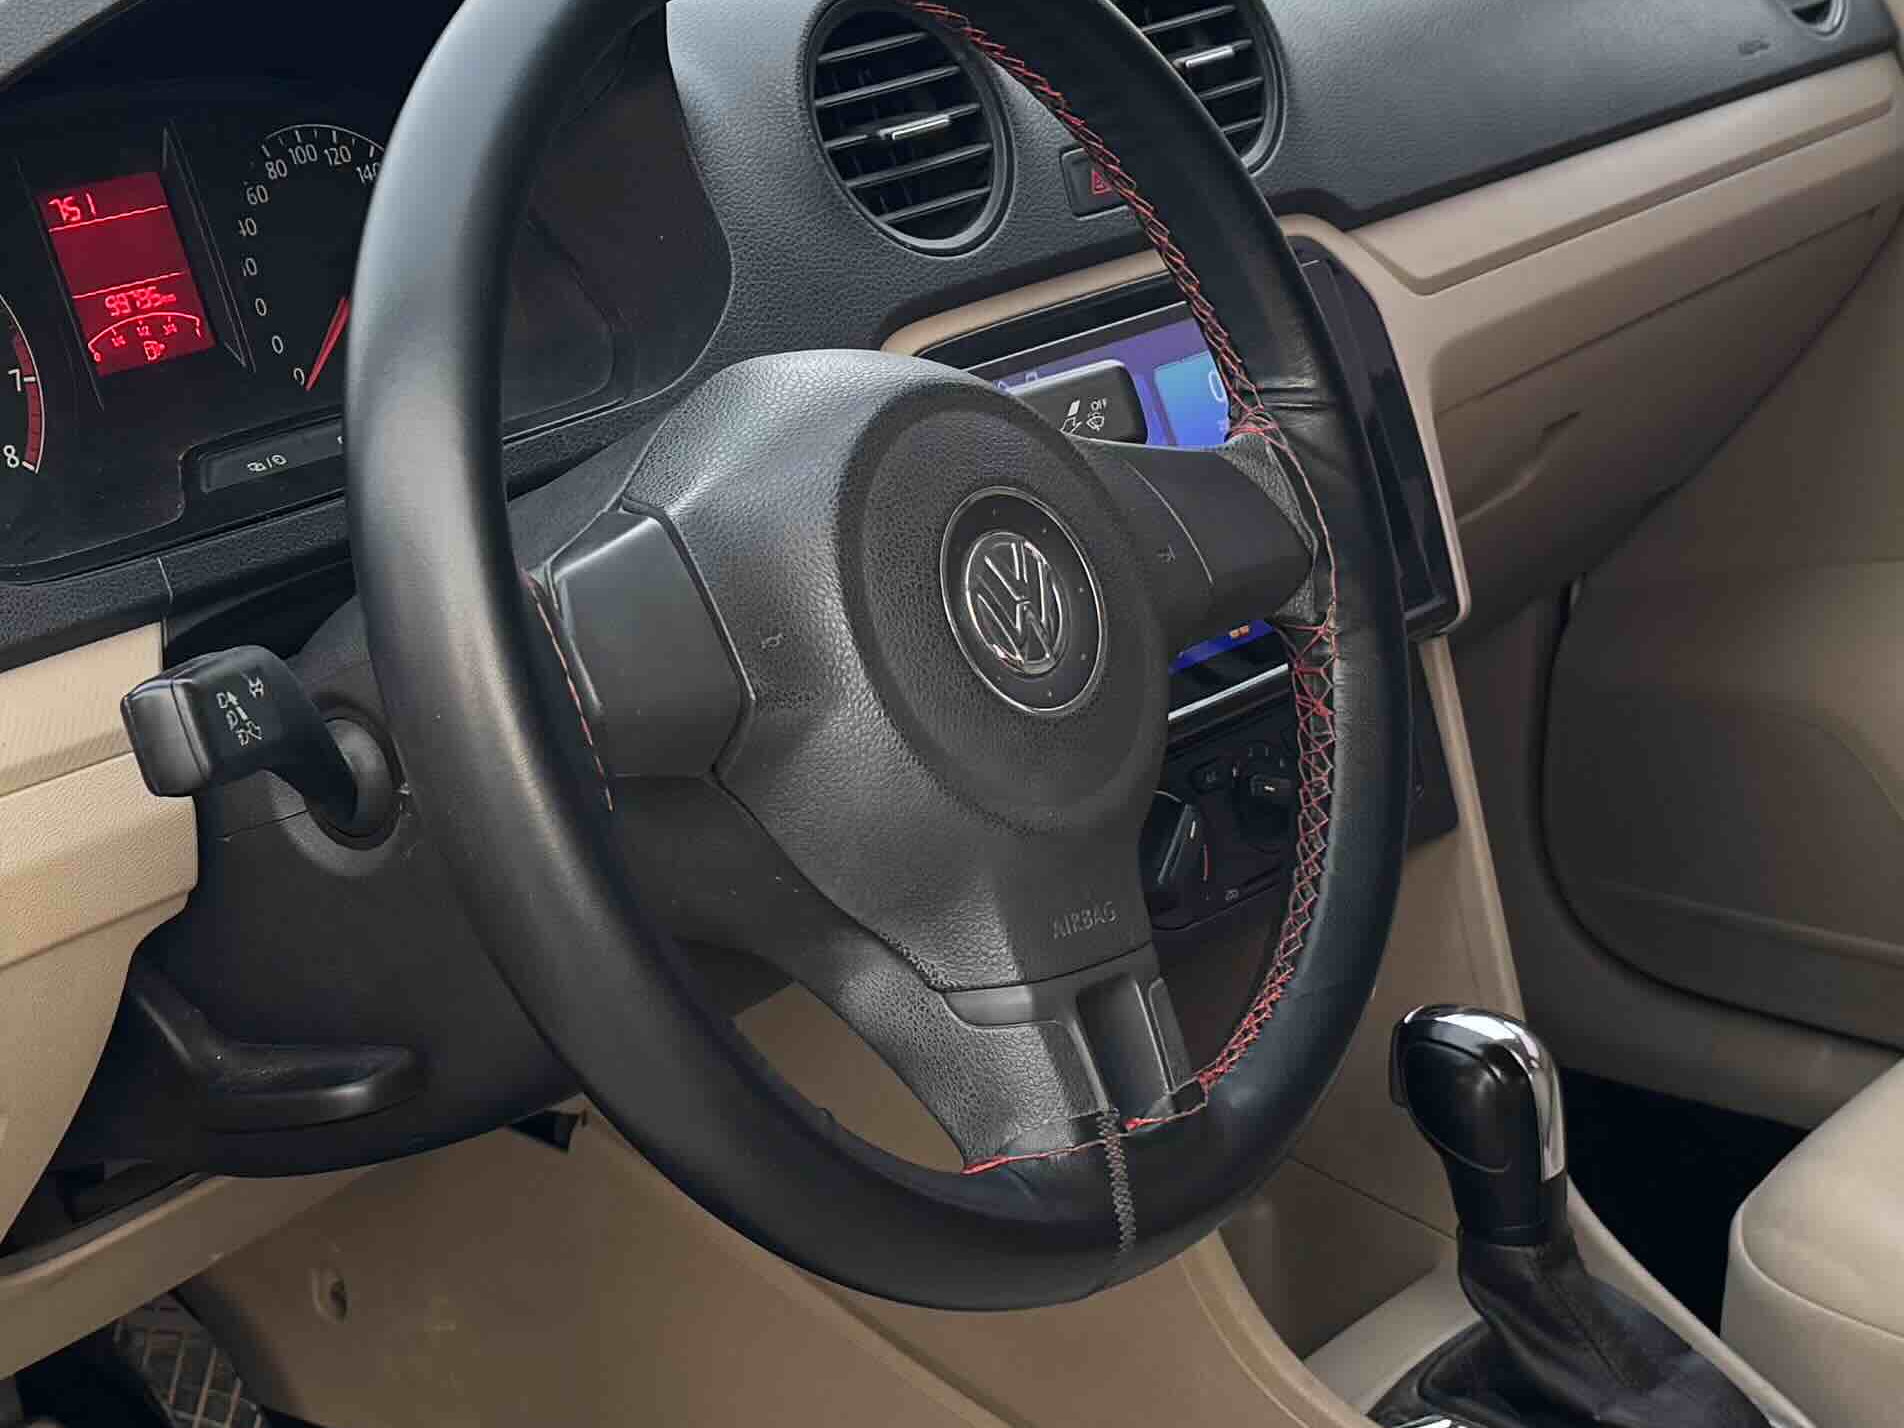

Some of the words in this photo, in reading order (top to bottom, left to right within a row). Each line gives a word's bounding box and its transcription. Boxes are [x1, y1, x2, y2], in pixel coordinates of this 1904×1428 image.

[289, 143, 318, 165] 100
[325, 145, 352, 167] 120
[265, 158, 288, 181] 80
[246, 184, 270, 206] 60
[7, 367, 22, 392] 7
[2, 444, 20, 469] 8
